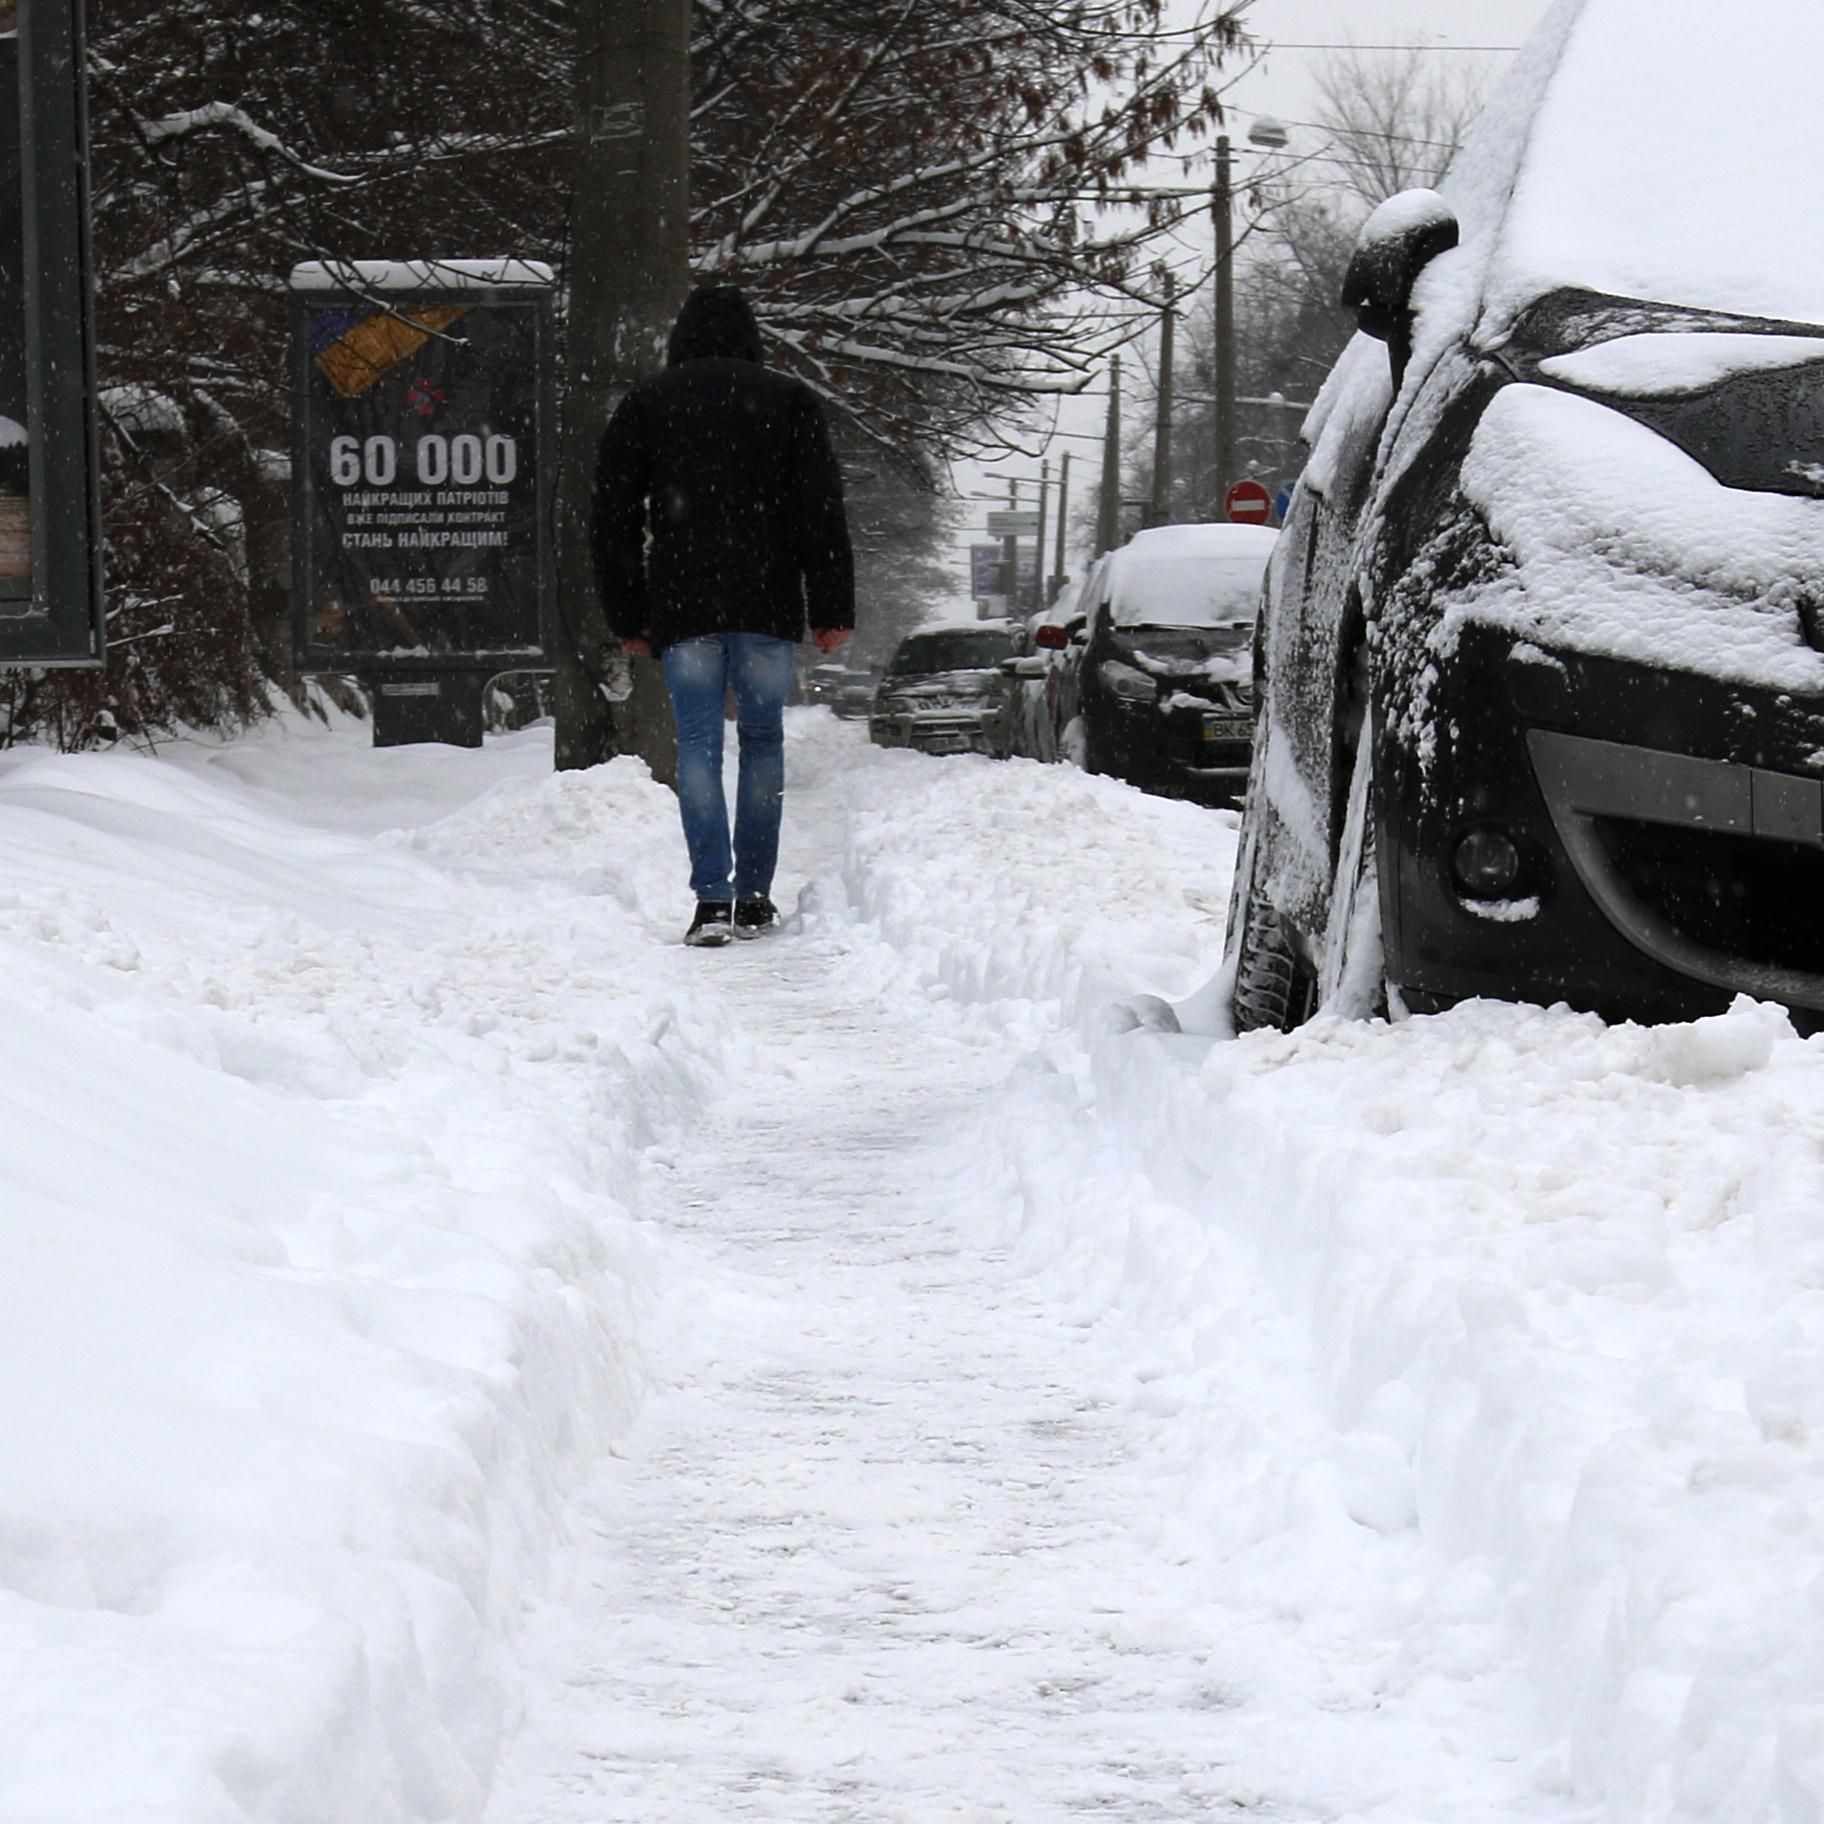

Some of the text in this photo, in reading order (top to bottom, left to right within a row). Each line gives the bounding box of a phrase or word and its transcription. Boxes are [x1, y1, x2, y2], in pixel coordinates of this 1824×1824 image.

[330, 433, 518, 486] 60 000
[342, 490, 510, 508] НАЙКРАЩИХ ПАТРІОТІВ
[346, 510, 506, 526] ВЖЕ ПІДПИСАЛИ КОНТРАКТ
[341, 528, 509, 549] СТАНЬ НАЙКРАЩИМ!
[370, 577, 488, 594] 044 456 44 58
[1214, 723, 1235, 737] BK
